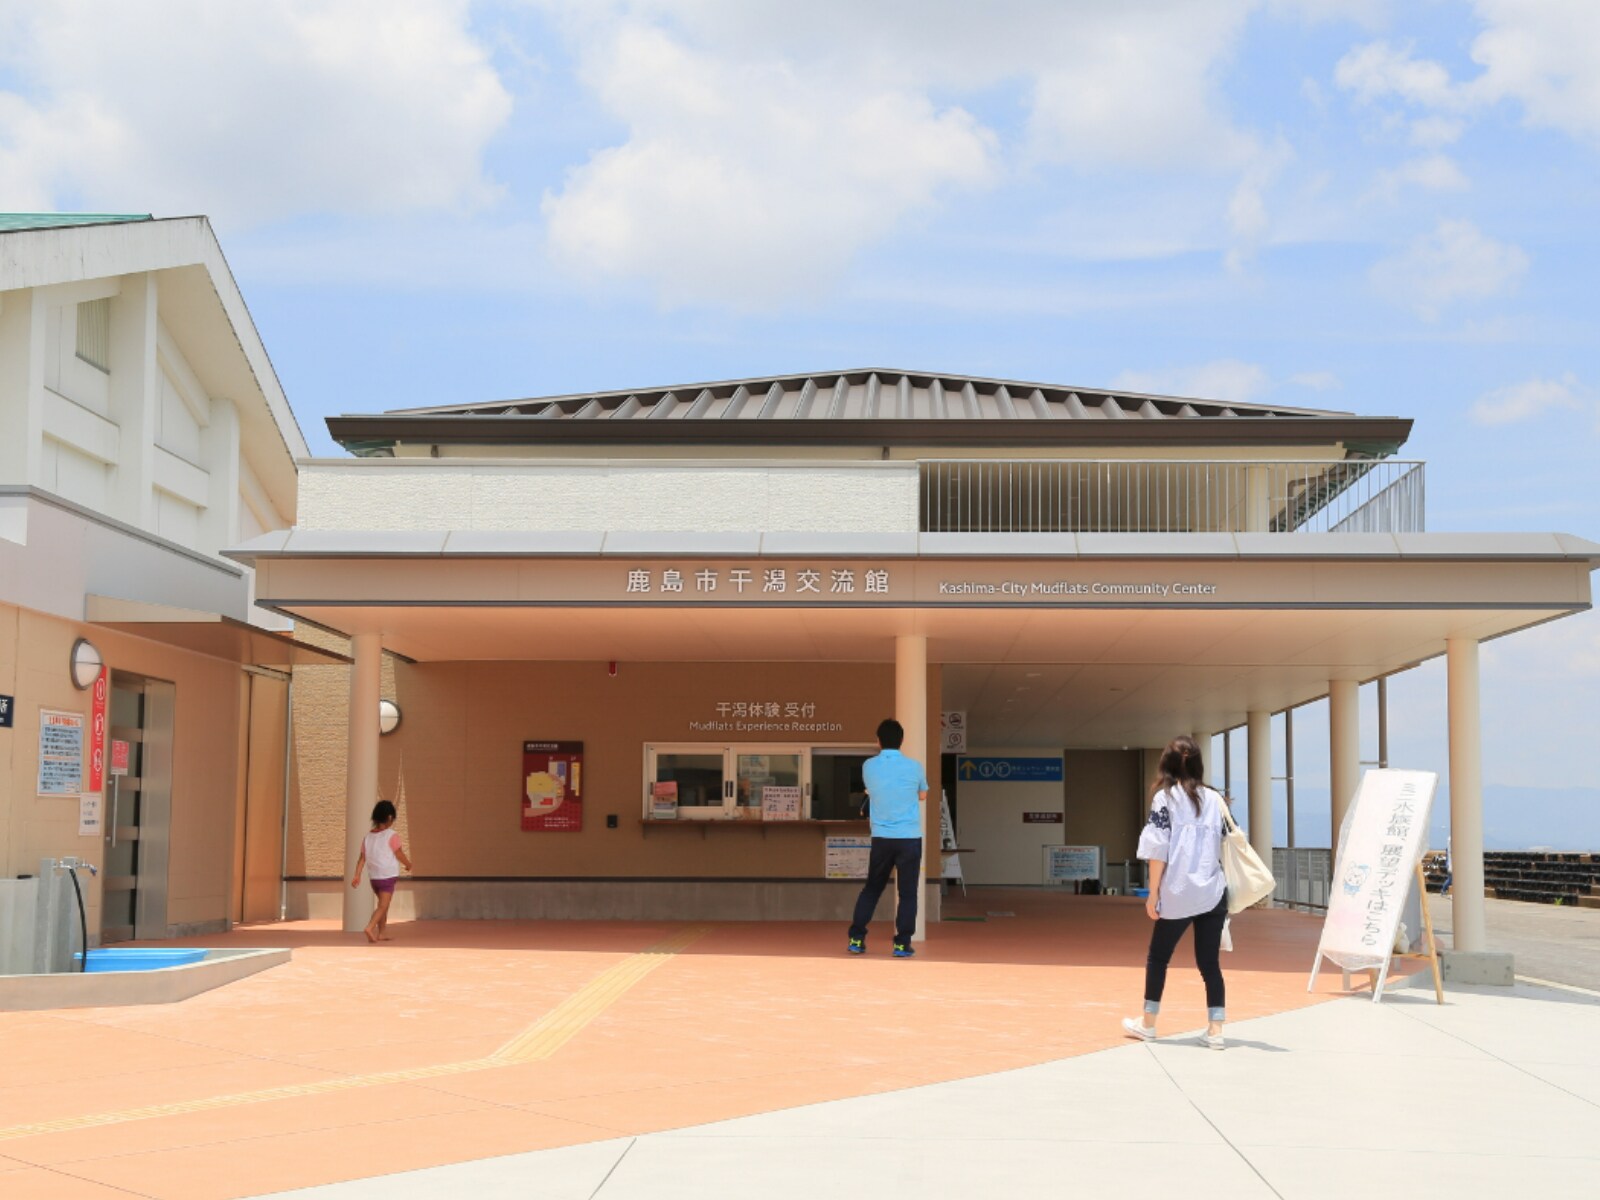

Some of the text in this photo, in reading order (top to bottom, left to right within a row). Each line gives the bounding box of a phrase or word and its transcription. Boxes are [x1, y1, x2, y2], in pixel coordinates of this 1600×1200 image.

[626, 569, 890, 594] 鹿島市干潟交流館
[939, 582, 1218, 597] Kashima-City Mudflats Community Center
[715, 702, 817, 718] 干潟体験 受付
[688, 721, 843, 733] Mudflats Experience Reception
